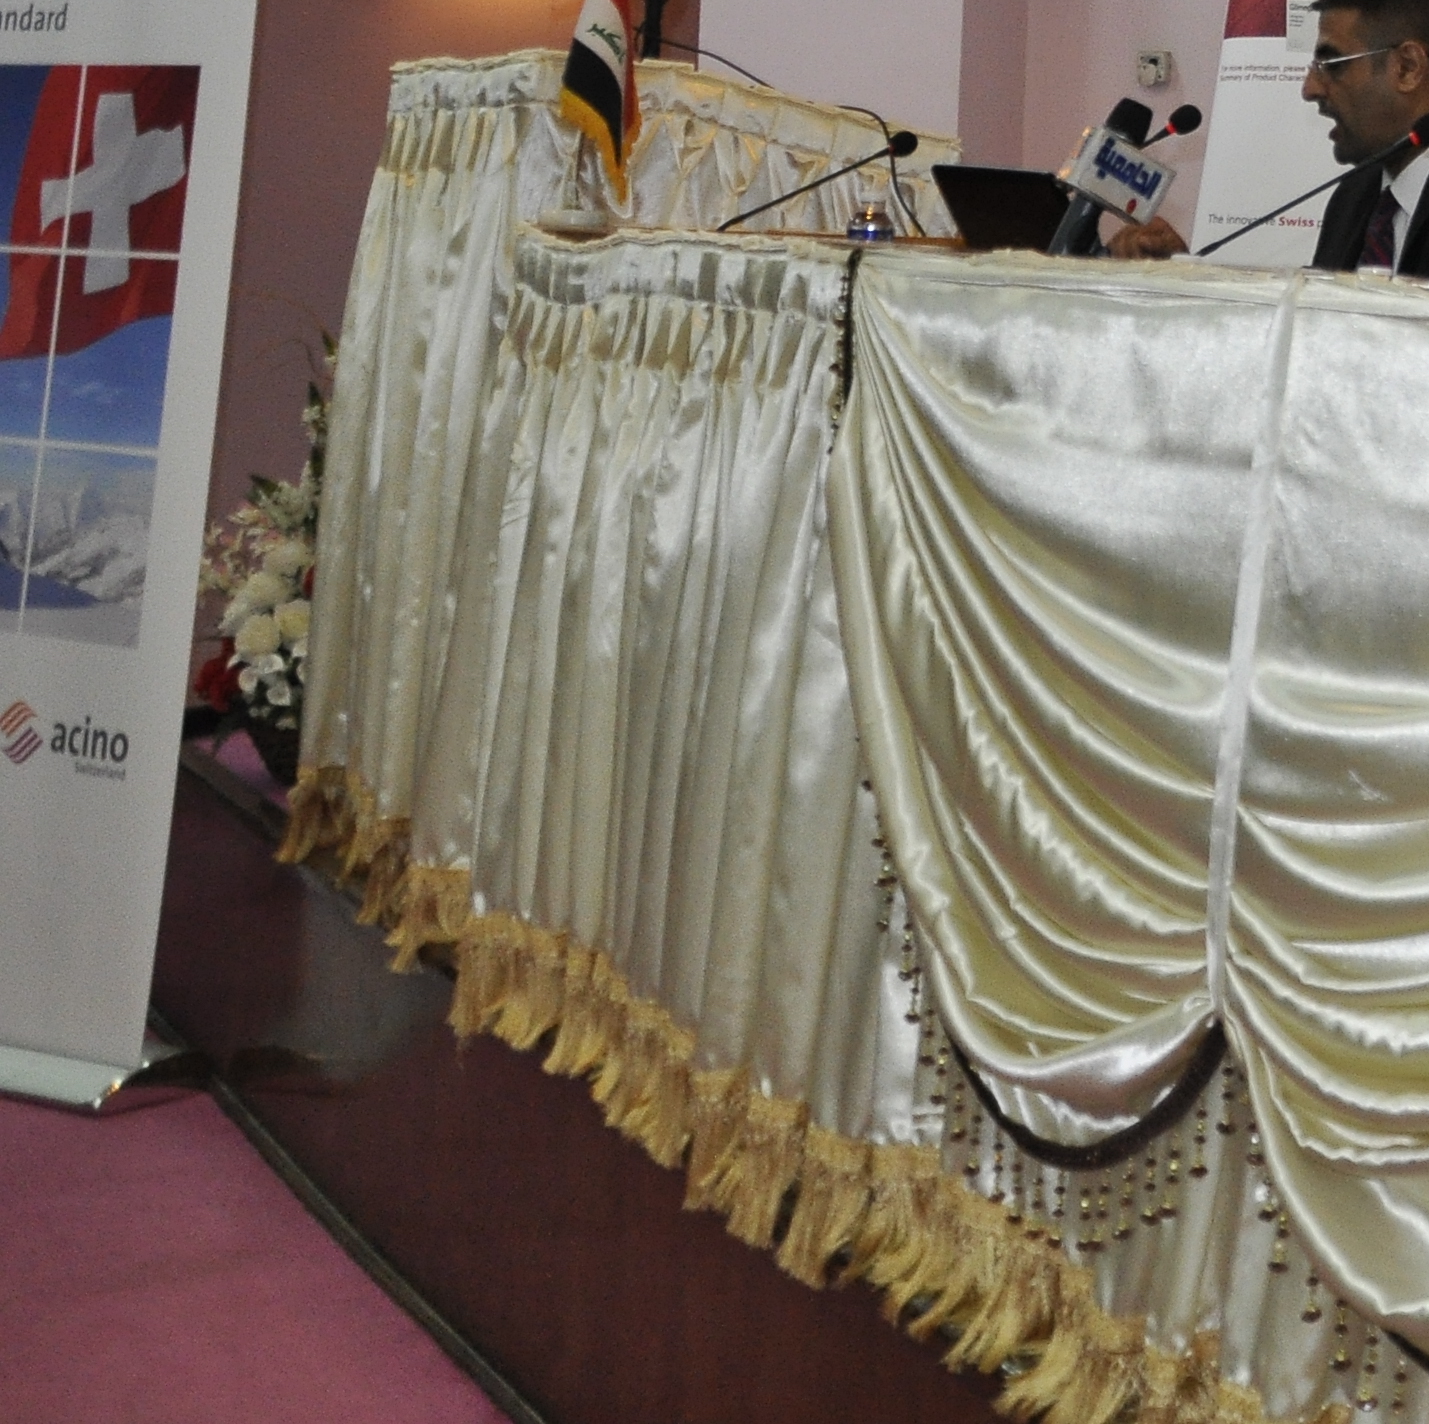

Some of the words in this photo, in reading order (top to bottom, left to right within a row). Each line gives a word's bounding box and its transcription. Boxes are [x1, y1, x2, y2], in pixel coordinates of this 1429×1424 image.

[0, 2, 69, 32] ndard
[1208, 214, 1223, 224] The
[1278, 216, 1315, 228] Swiss
[50, 715, 129, 763] acino
